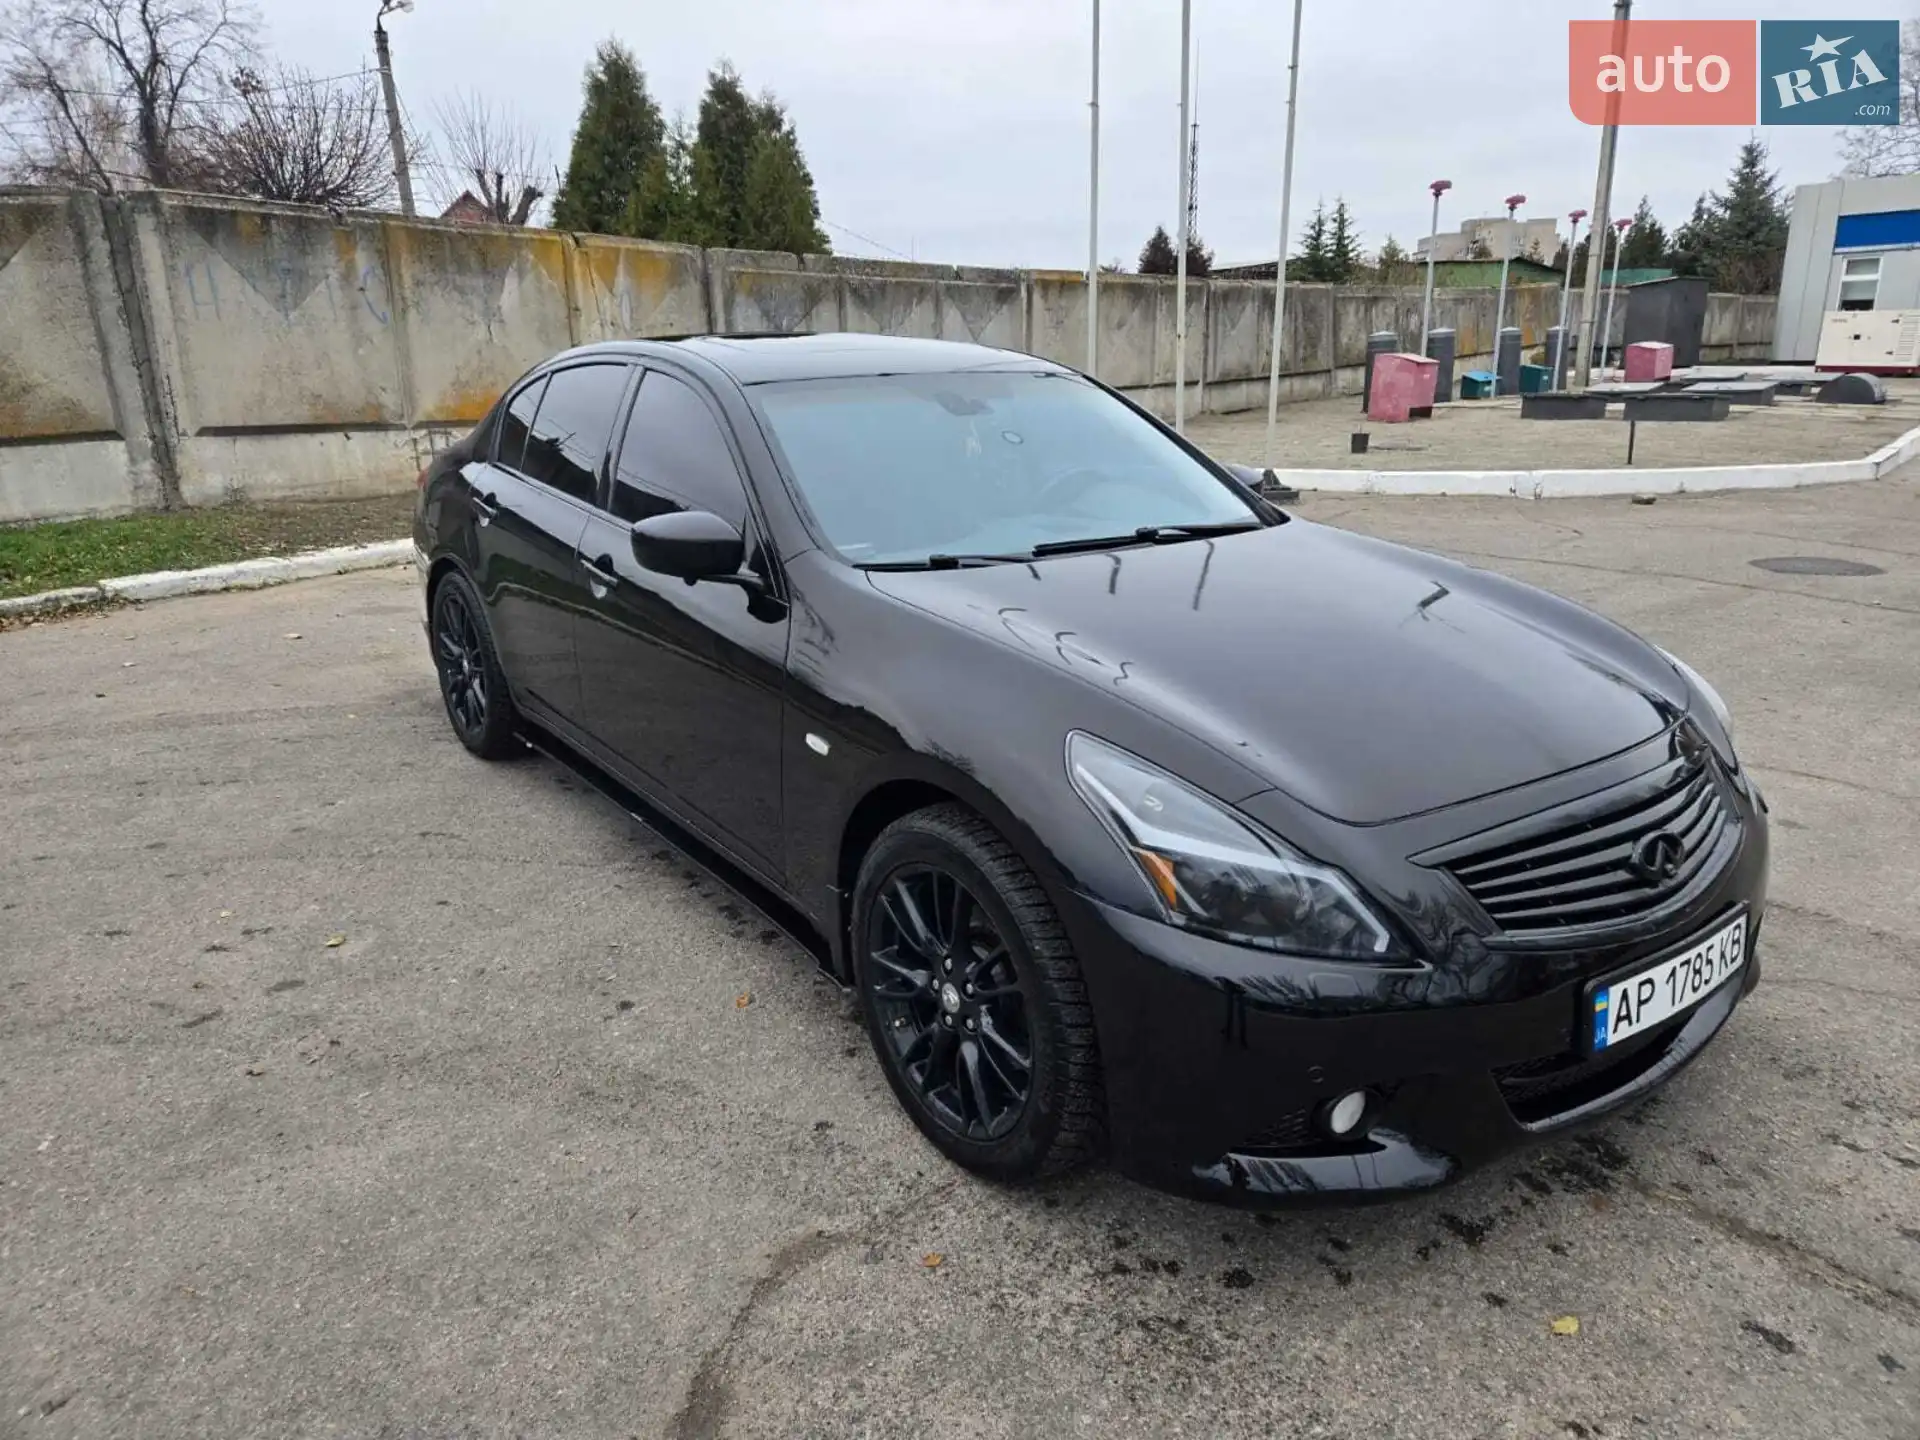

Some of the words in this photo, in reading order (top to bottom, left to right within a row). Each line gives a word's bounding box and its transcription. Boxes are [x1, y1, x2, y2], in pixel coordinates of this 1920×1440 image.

[1612, 977, 1656, 1034] AP
[1666, 943, 1715, 1008] 1785
[1718, 922, 1743, 977] KB
